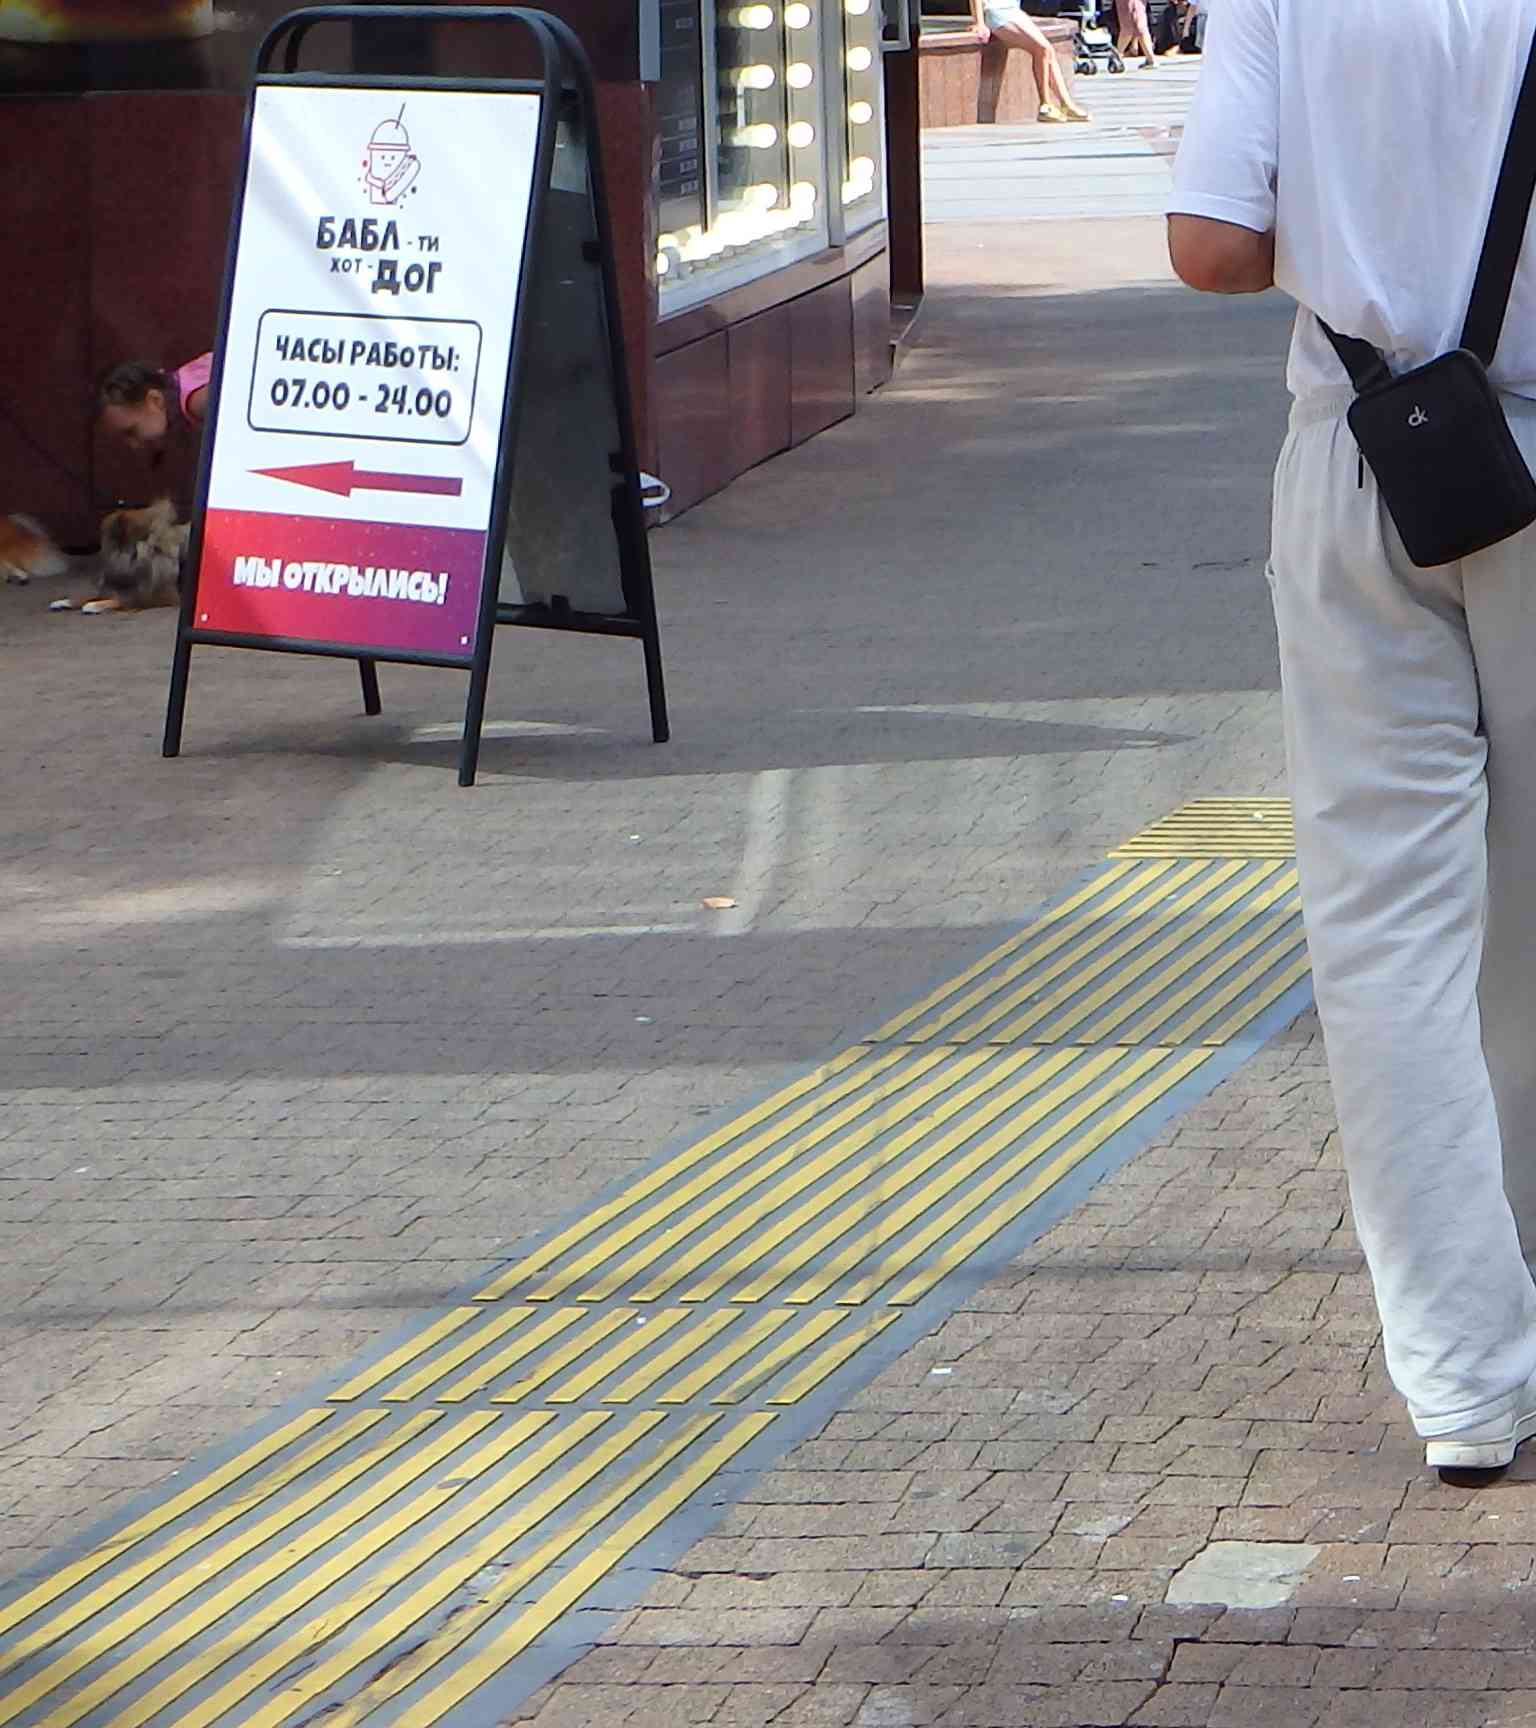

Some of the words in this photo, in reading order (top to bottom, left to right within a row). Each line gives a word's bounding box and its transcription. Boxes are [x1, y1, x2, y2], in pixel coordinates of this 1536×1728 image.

[316, 215, 401, 251] БАБЛ
[418, 235, 440, 253] ТИ
[331, 257, 364, 275] ХОТ
[372, 258, 443, 295] ДОГ
[275, 334, 345, 365] ЧАСЫ
[350, 339, 461, 373] РАБОТЫ:
[270, 377, 350, 411] 07.00
[374, 383, 453, 418] 24.00
[233, 555, 284, 589] МЫ
[284, 560, 450, 606] ОТКРЫЛИСЬ!
